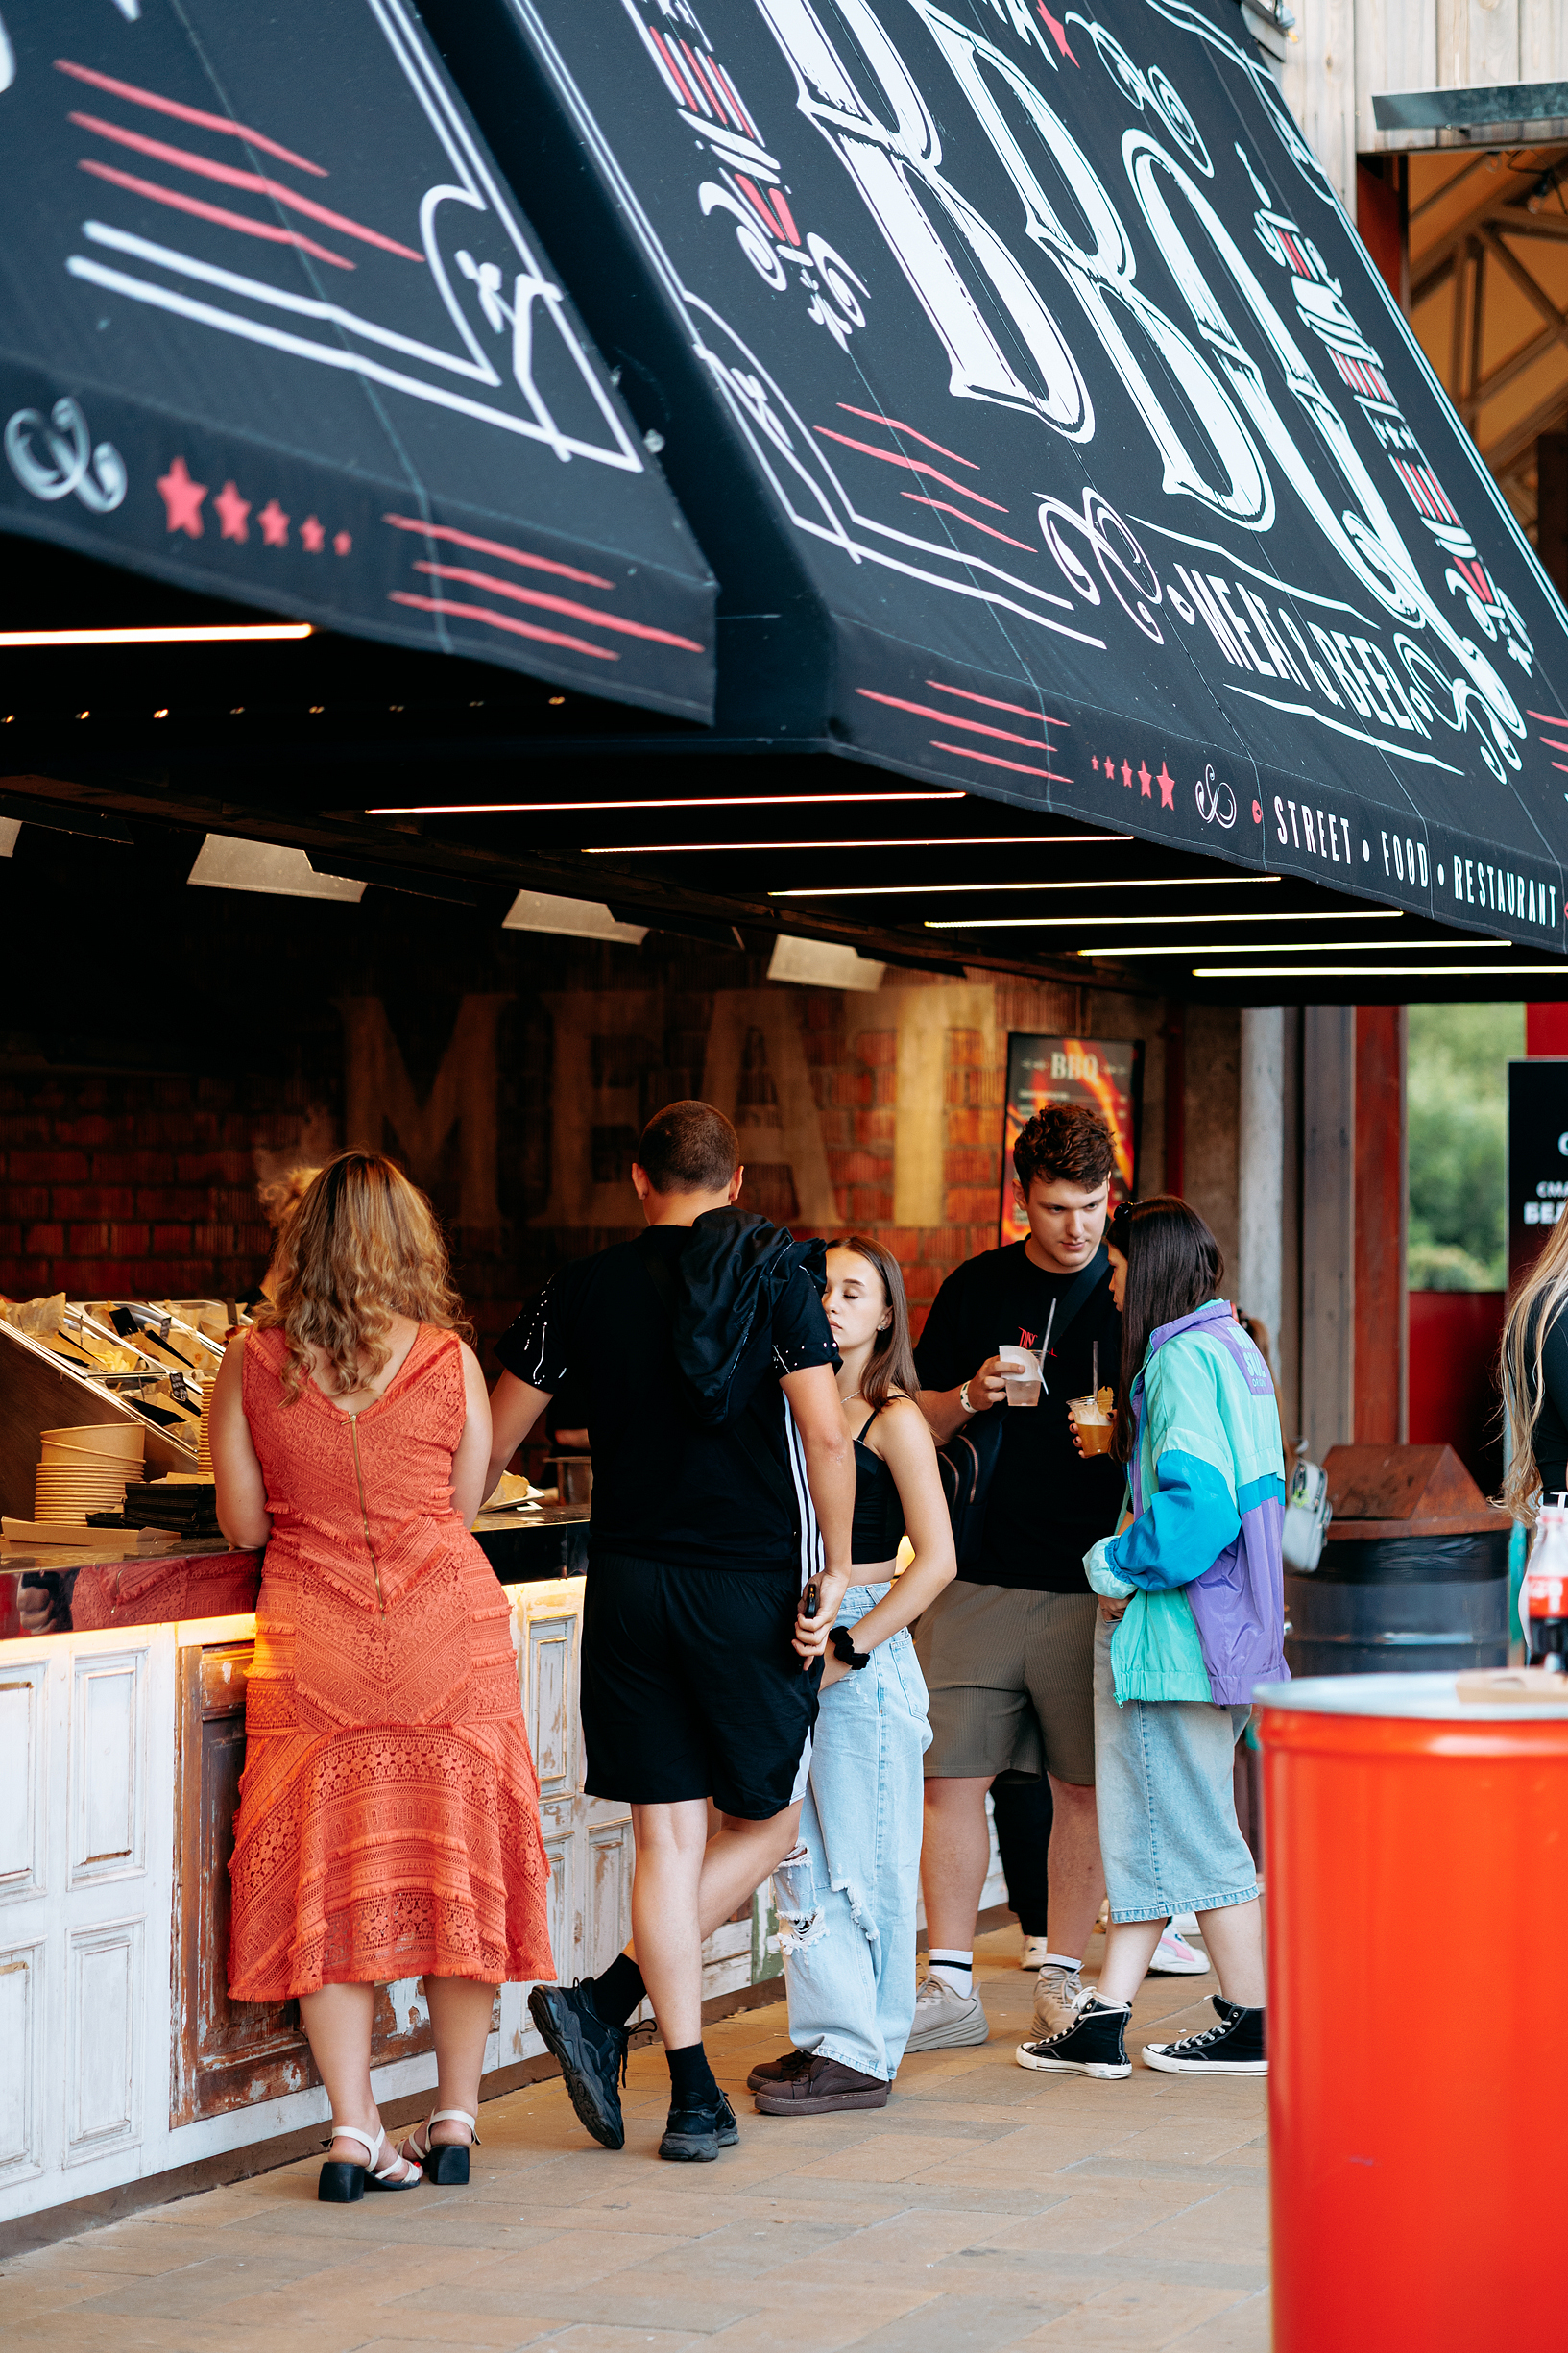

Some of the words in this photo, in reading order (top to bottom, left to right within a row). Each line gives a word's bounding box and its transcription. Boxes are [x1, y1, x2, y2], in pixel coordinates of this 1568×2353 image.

[752, 0, 1529, 783] BBQ
[1173, 563, 1310, 691] MEAT
[1277, 609, 1346, 709] &
[1306, 620, 1432, 740] BEER
[1273, 796, 1351, 865] STREET
[1381, 831, 1430, 888] FOOD
[1453, 856, 1557, 928] RESTAURANT
[332, 985, 995, 1227] MEAT
[1050, 1051, 1099, 1080] BBQ
